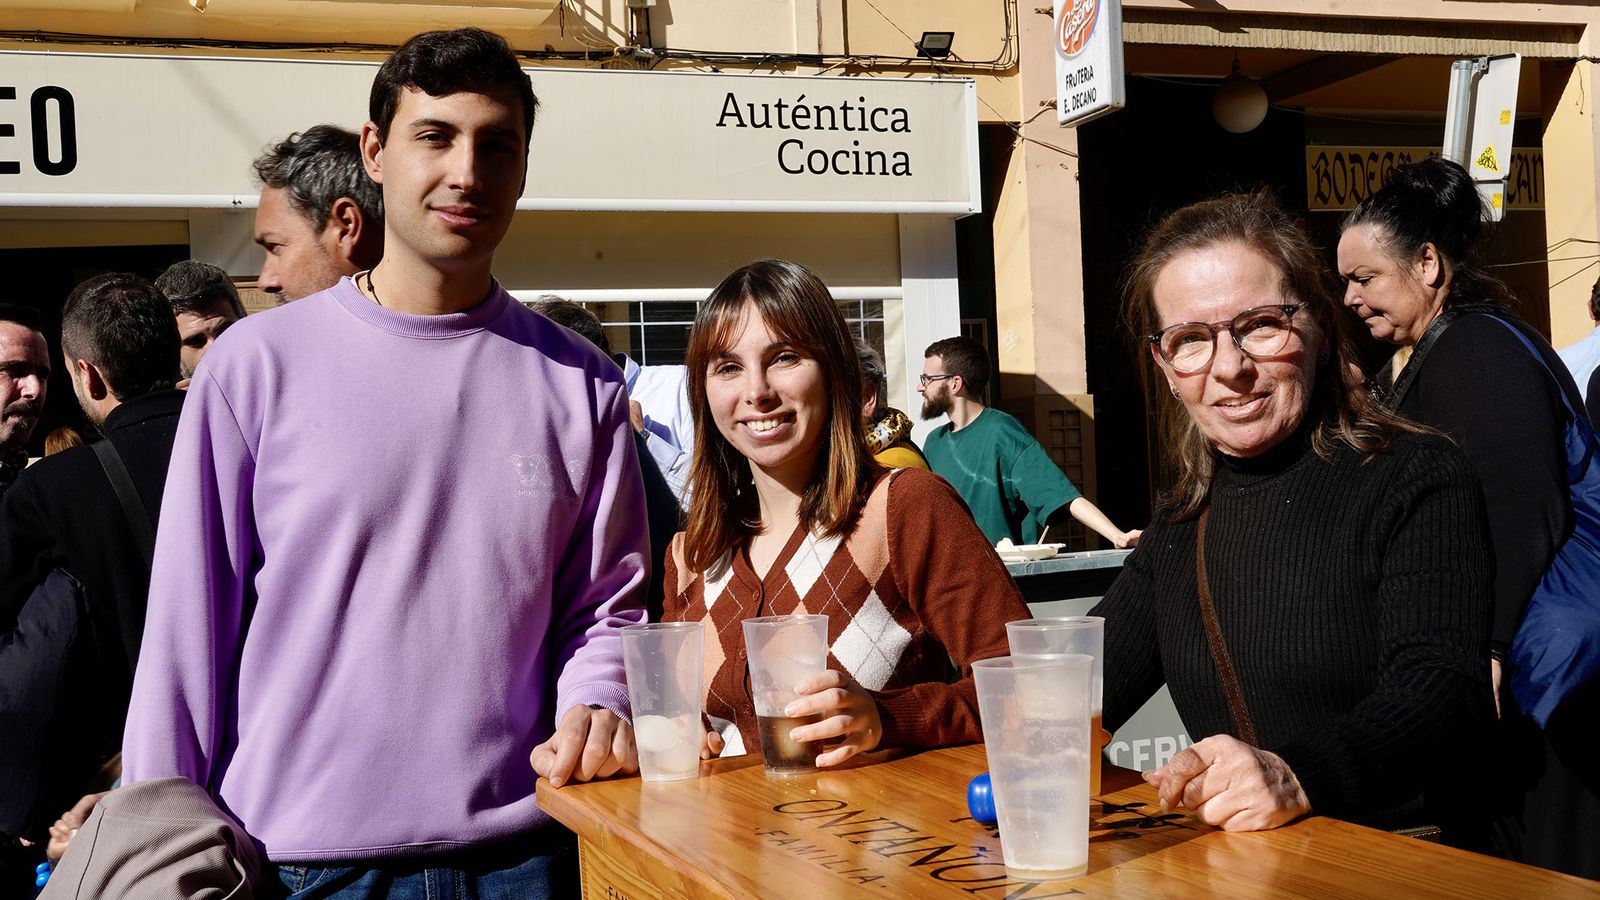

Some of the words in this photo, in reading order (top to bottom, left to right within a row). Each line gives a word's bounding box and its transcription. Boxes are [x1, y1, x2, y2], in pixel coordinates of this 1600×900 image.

[715, 92, 911, 133] Auténtica
[1063, 98, 1071, 114] E.
[1072, 87, 1097, 111] DECANO
[777, 138, 912, 176] Cocina
